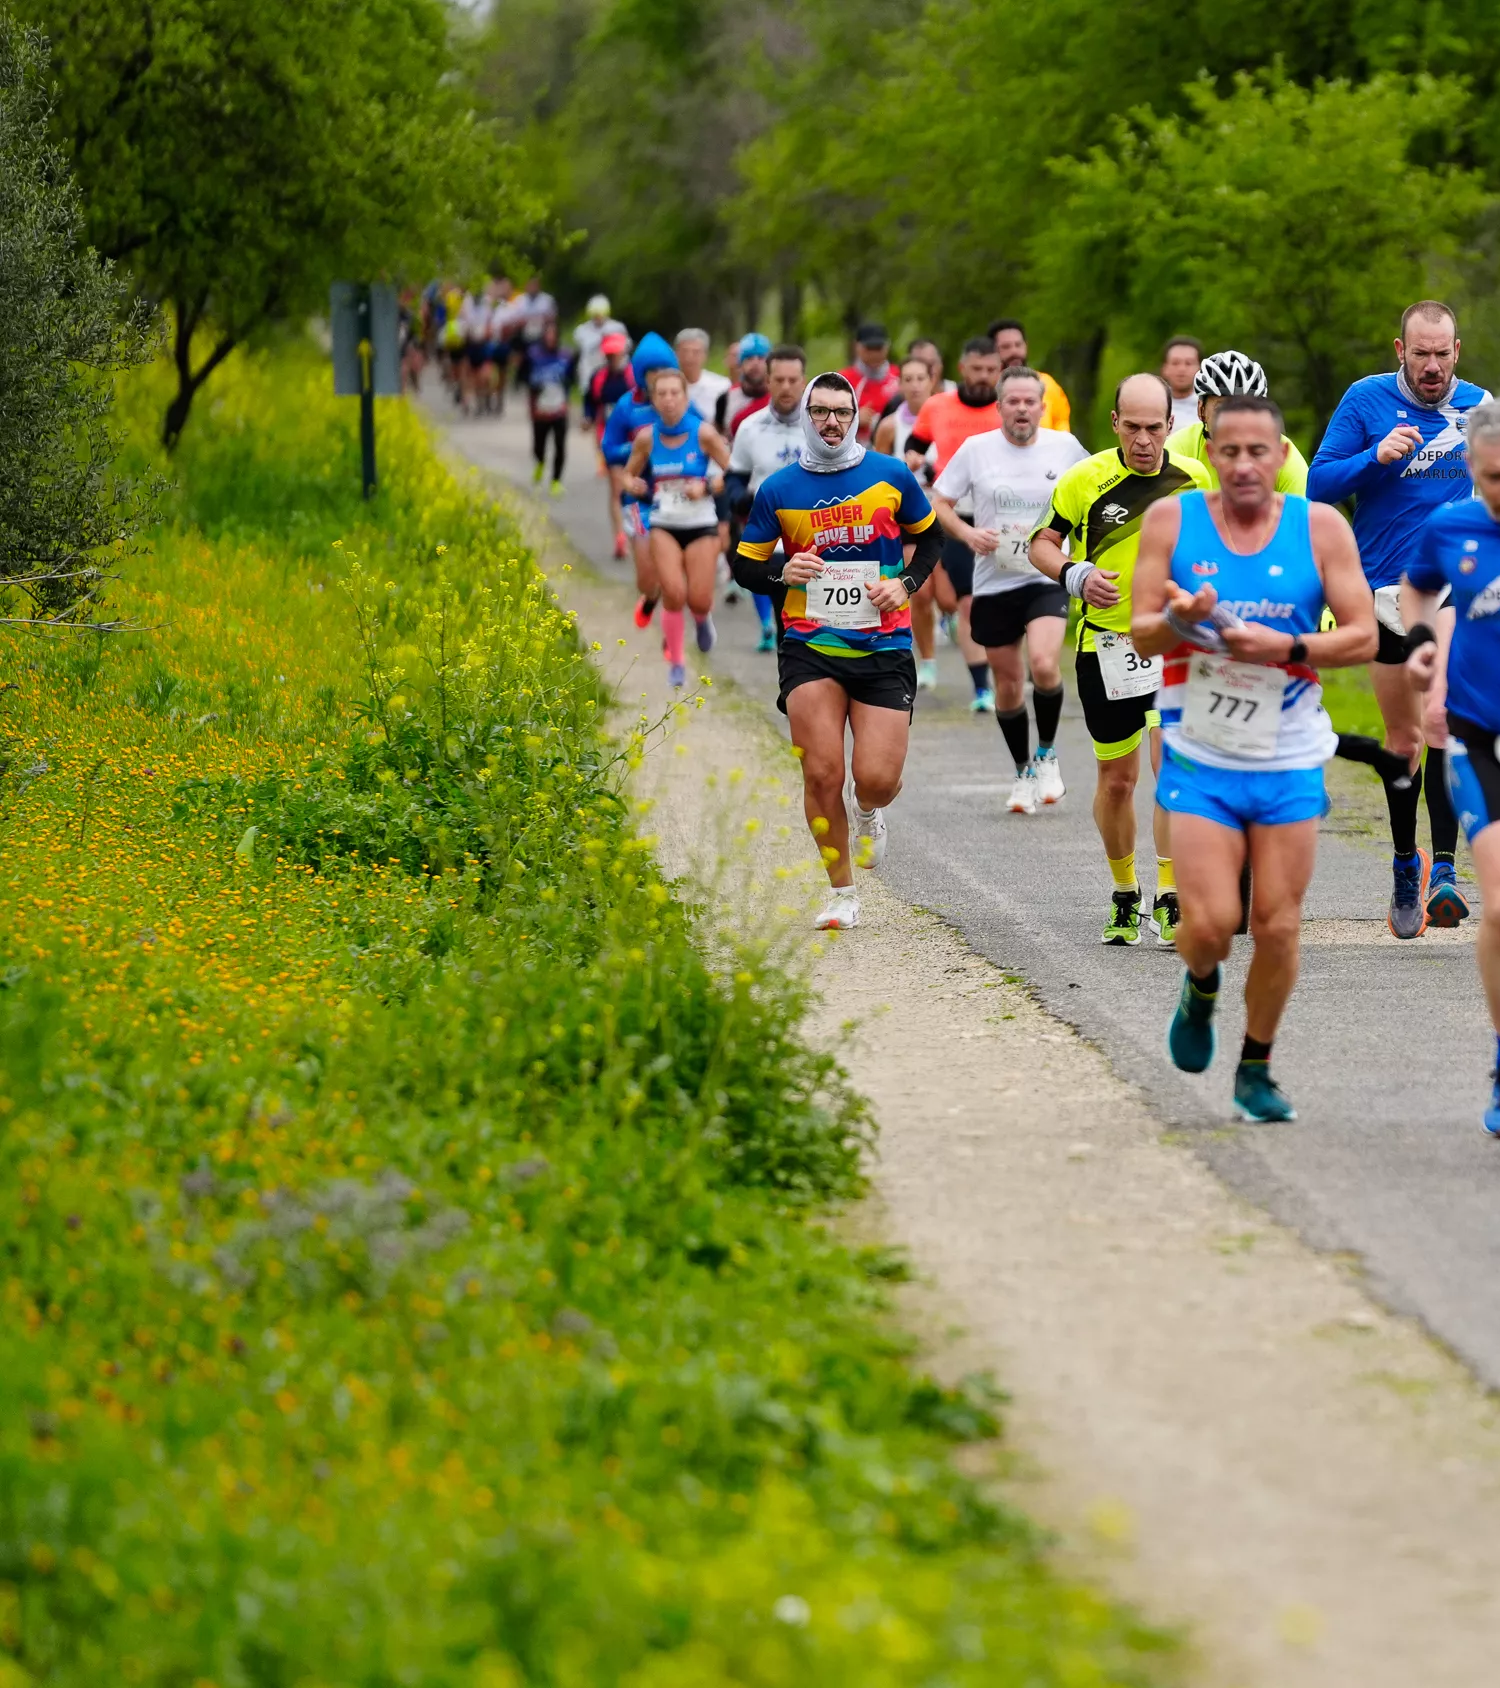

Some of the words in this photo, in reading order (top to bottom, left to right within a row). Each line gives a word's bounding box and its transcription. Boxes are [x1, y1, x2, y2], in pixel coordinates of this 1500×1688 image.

[1098, 474, 1121, 492] Joma
[1404, 467, 1467, 479] AXARLÓN
[810, 505, 863, 528] NEVER
[814, 526, 849, 546] GIVE
[853, 524, 874, 543] UP
[823, 587, 861, 606] 709
[1208, 691, 1260, 723] 777
